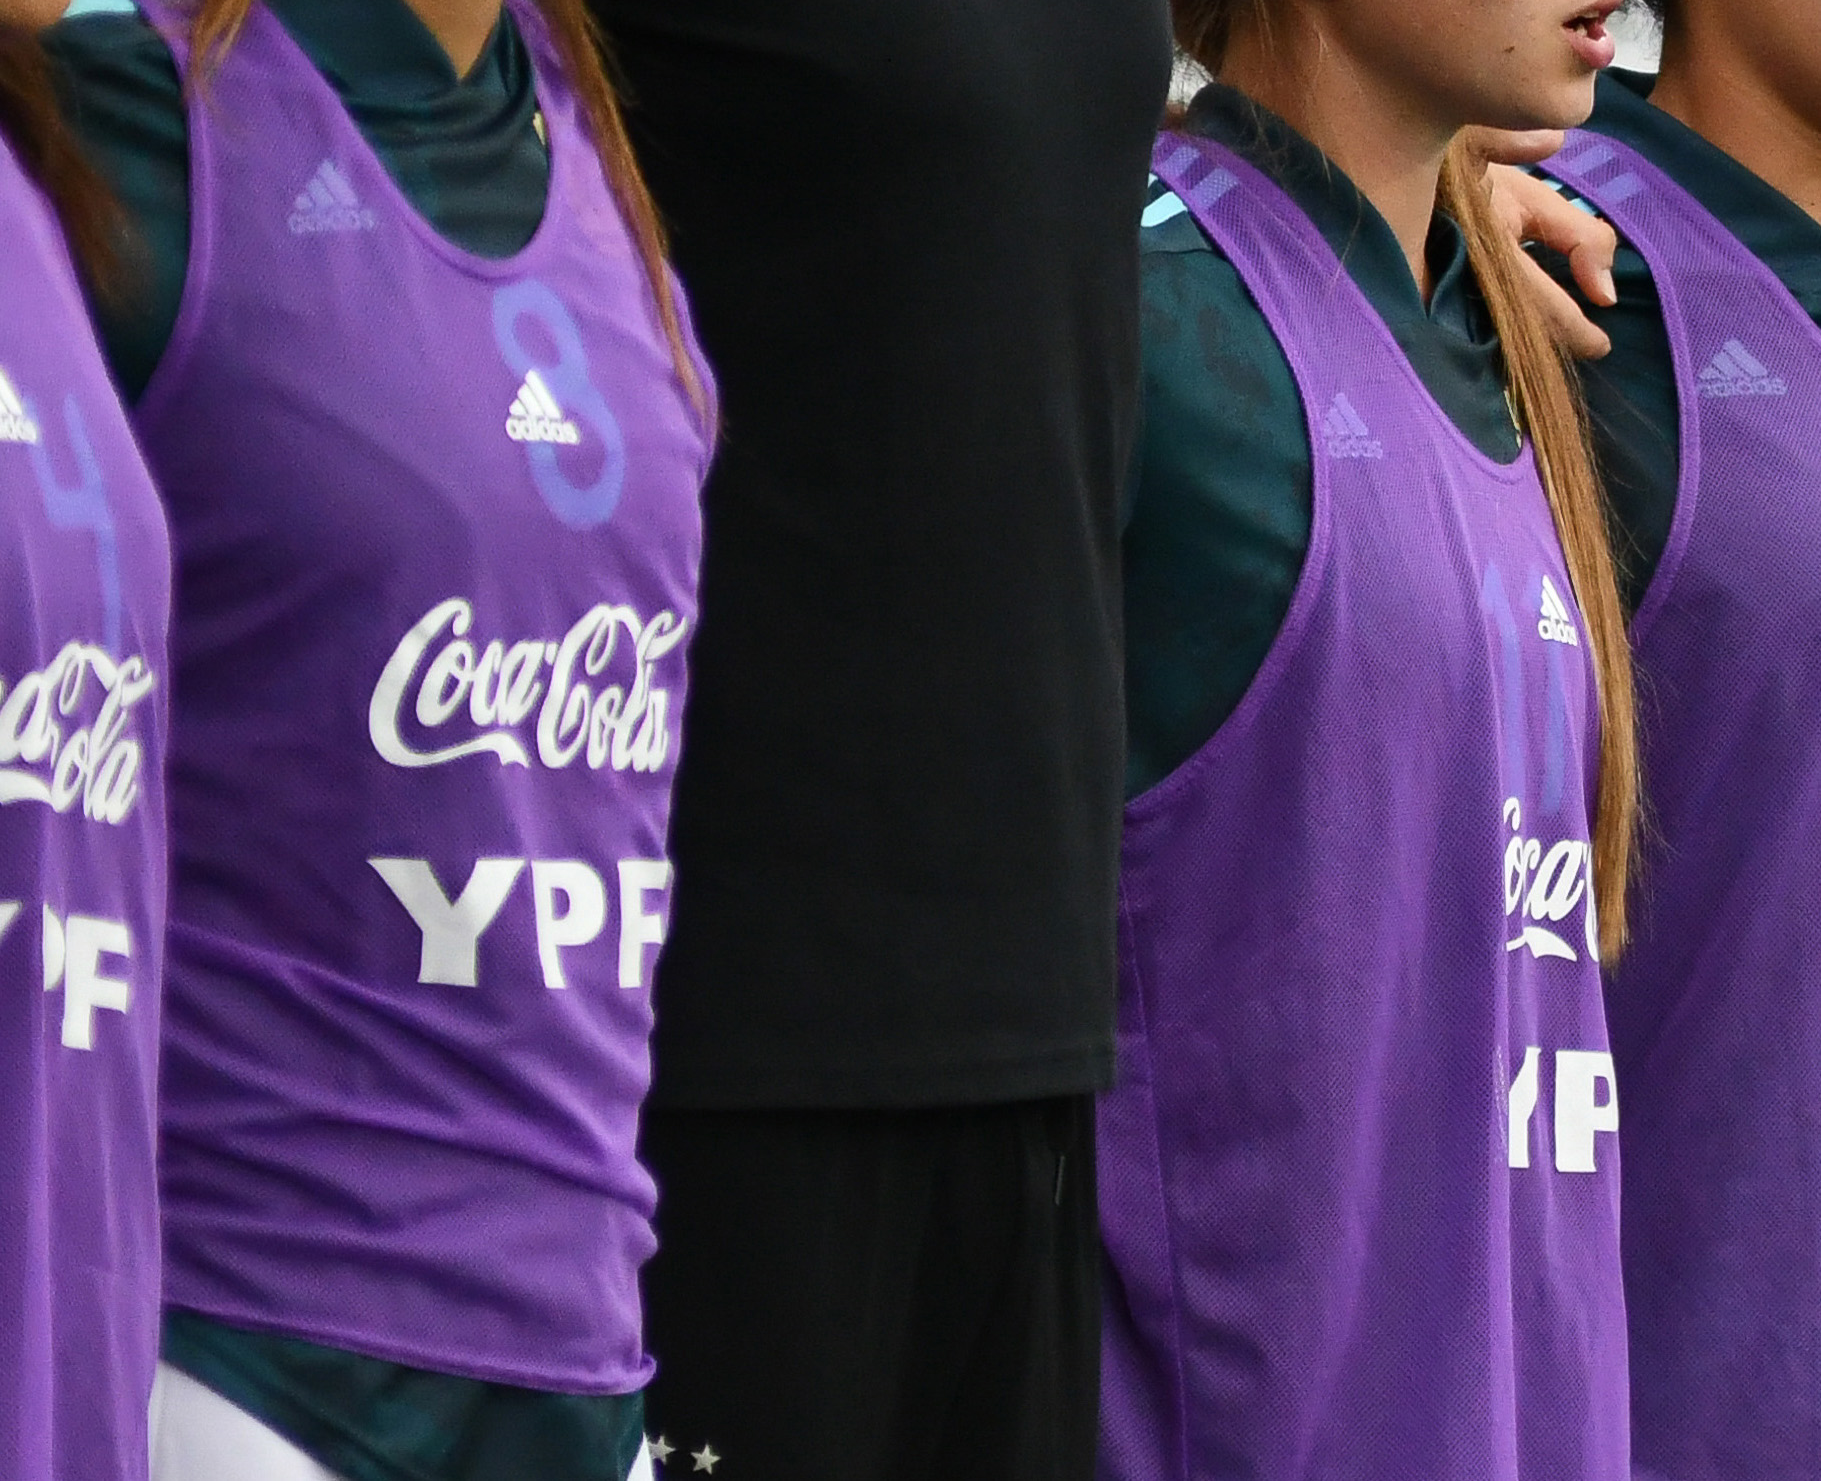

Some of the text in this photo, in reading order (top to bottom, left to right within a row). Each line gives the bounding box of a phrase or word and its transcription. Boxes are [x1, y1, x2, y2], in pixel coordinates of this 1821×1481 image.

[493, 278, 625, 530] 8
[506, 417, 580, 444] adidas
[22, 392, 122, 660] 4
[369, 598, 687, 772] Coca-Cola
[1480, 558, 1566, 815] 11
[366, 858, 671, 989] YPF
[1508, 1046, 1620, 1173] YP
